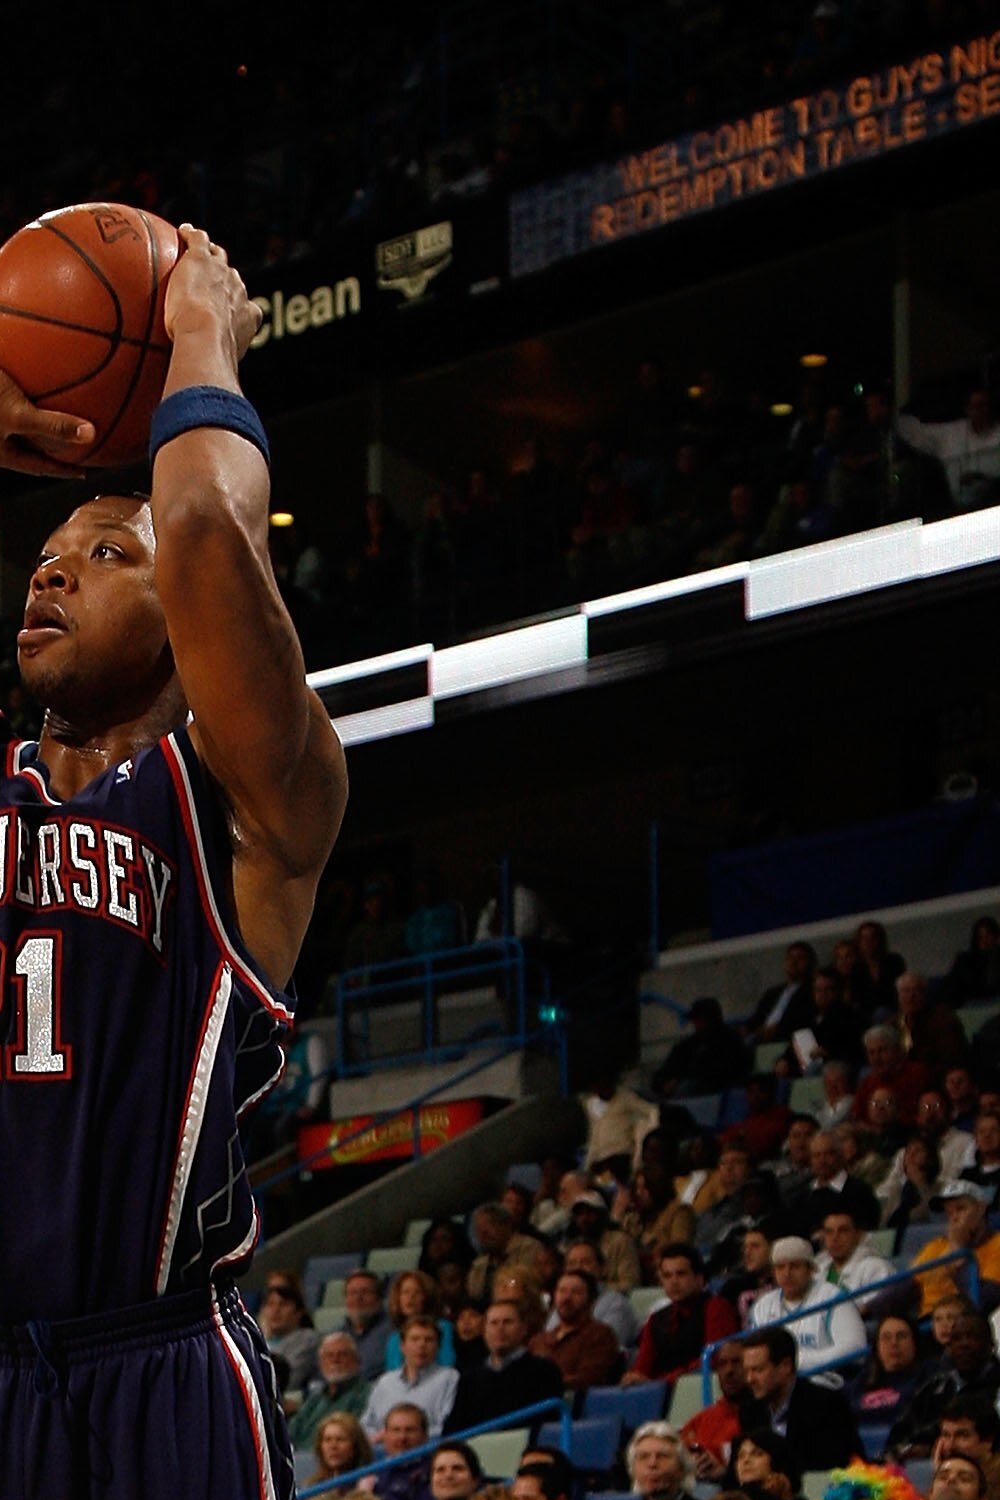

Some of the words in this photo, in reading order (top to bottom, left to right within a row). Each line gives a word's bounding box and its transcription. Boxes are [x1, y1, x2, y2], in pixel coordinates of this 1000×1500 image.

[591, 141, 805, 241] REDEMPTION
[817, 101, 927, 168] TABLE
[619, 108, 784, 191] WELCOME
[793, 89, 839, 135] TO
[848, 53, 944, 116] GUYS
